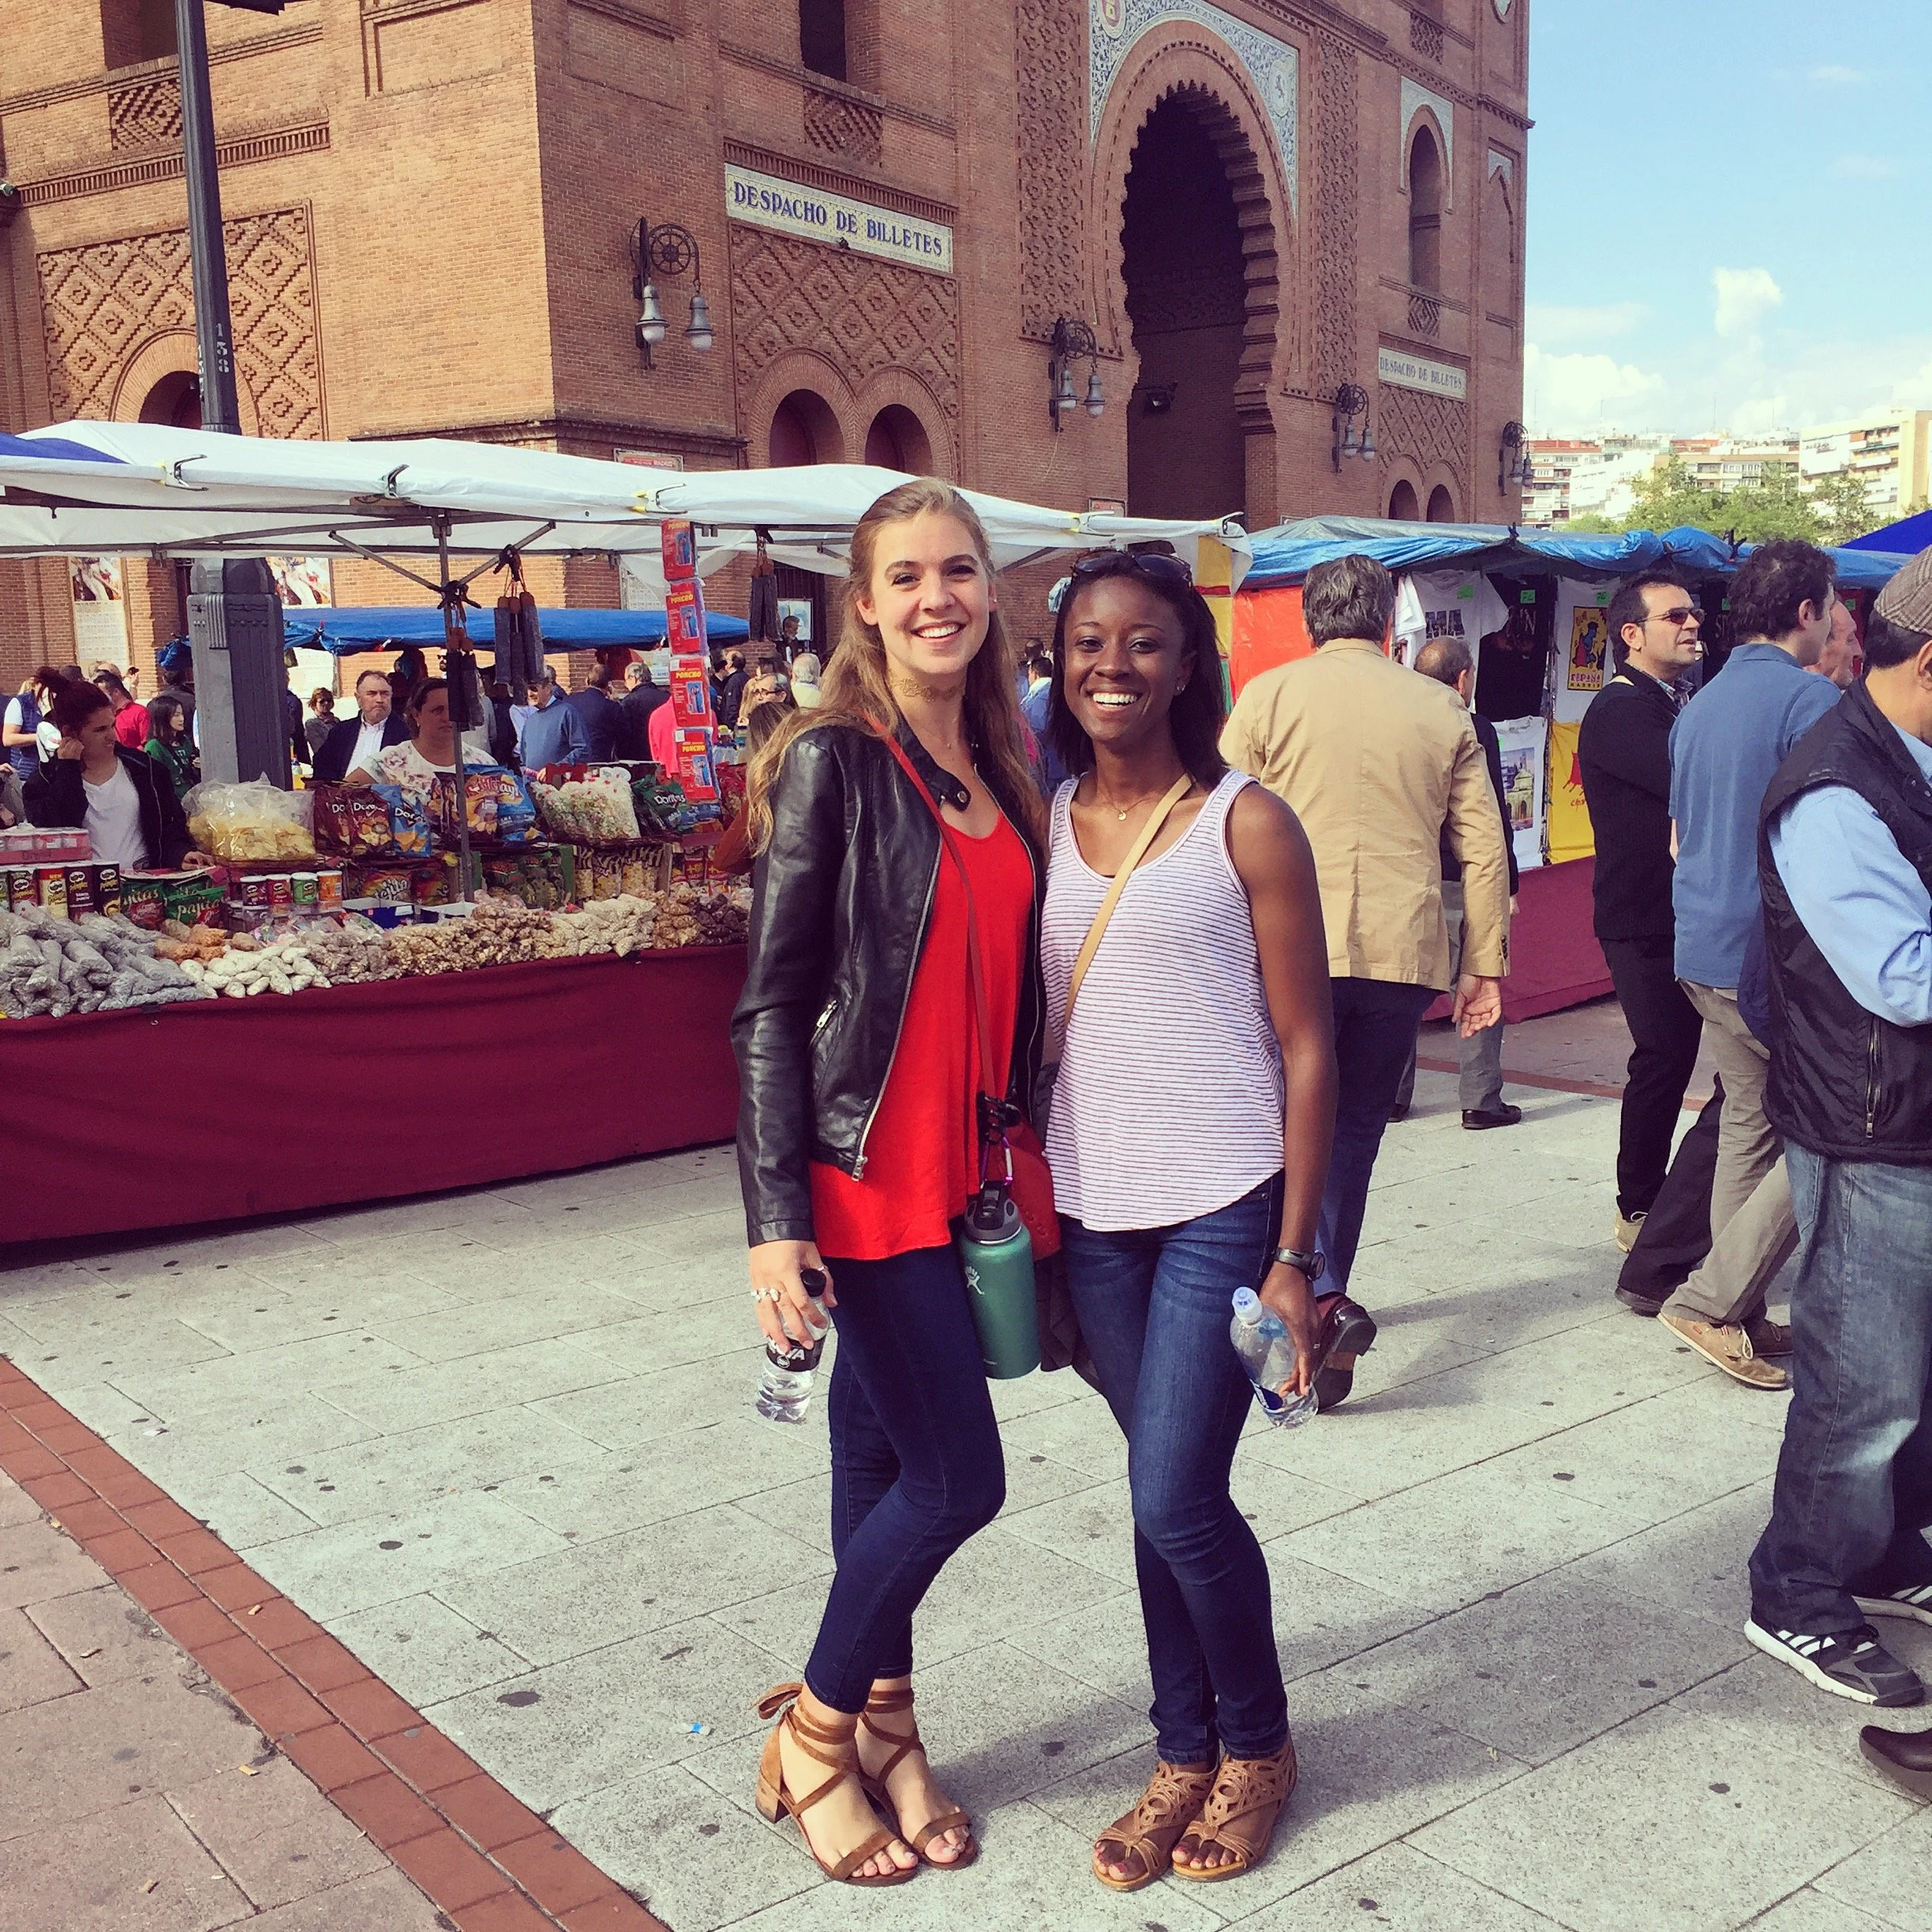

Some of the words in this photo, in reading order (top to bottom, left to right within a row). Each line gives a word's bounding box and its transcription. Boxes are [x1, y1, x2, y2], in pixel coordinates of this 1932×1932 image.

[733, 182, 827, 227] DESPACHO
[836, 210, 858, 234] DE
[867, 219, 942, 257] BILLETES
[1380, 357, 1416, 378] DESPACHO
[1418, 367, 1428, 381] DE
[1431, 369, 1462, 389] BILLETES
[653, 794, 687, 805] Doritos
